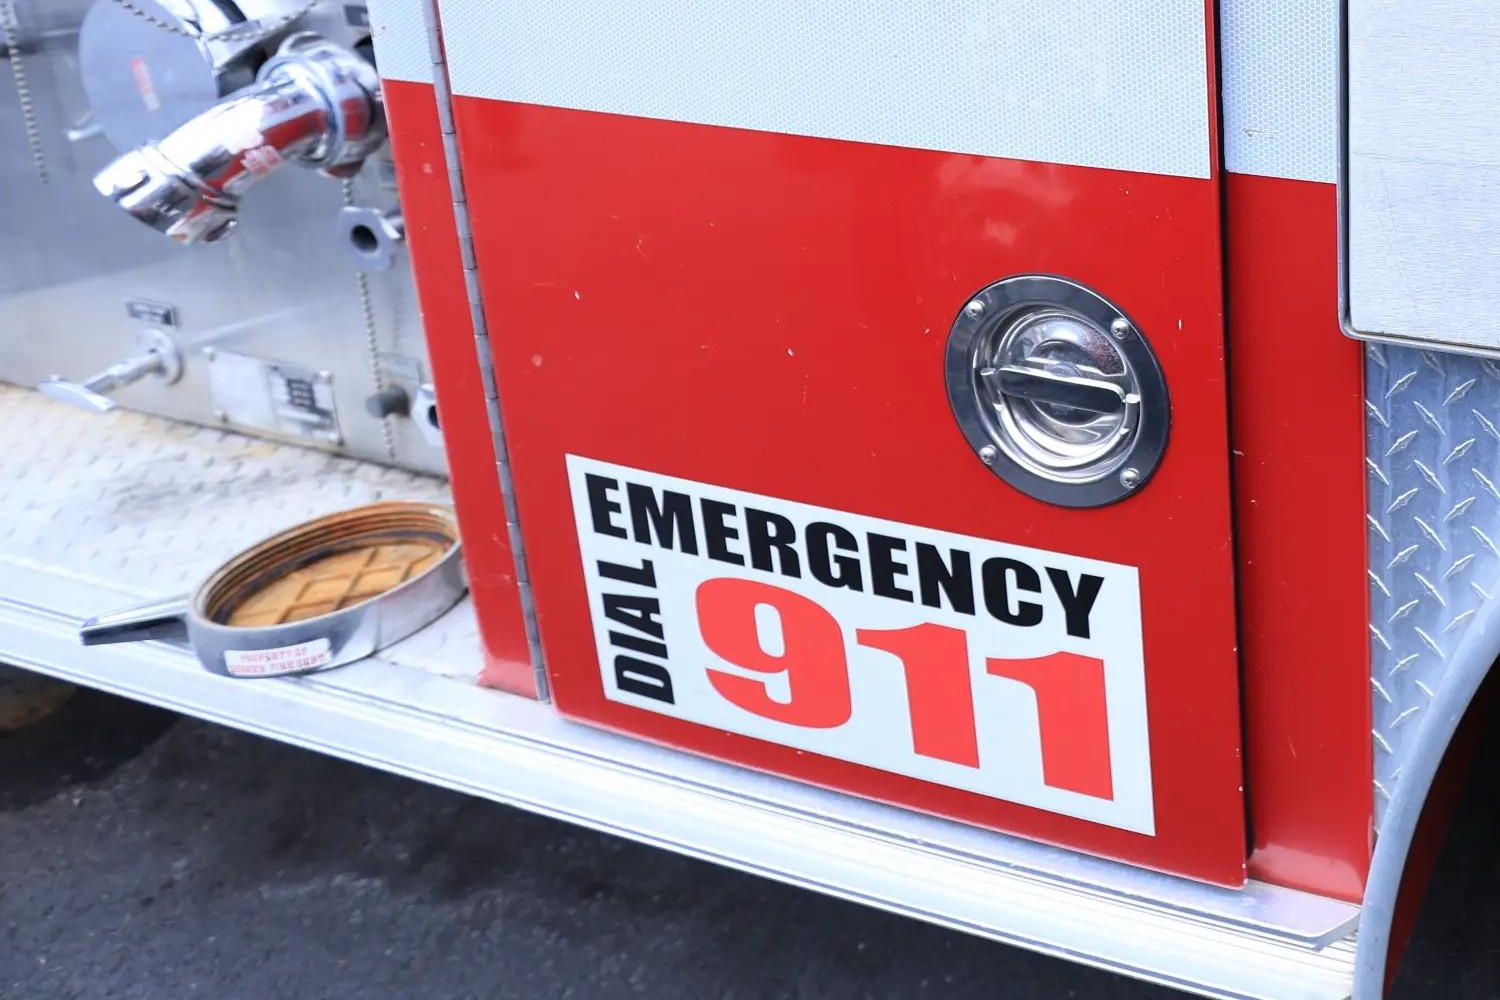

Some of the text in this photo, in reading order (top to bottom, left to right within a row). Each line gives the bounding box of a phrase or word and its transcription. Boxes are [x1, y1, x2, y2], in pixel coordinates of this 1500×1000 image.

[585, 473, 1105, 639] EMERGENCY
[597, 559, 675, 705] DIAL
[696, 577, 1114, 802] 911
